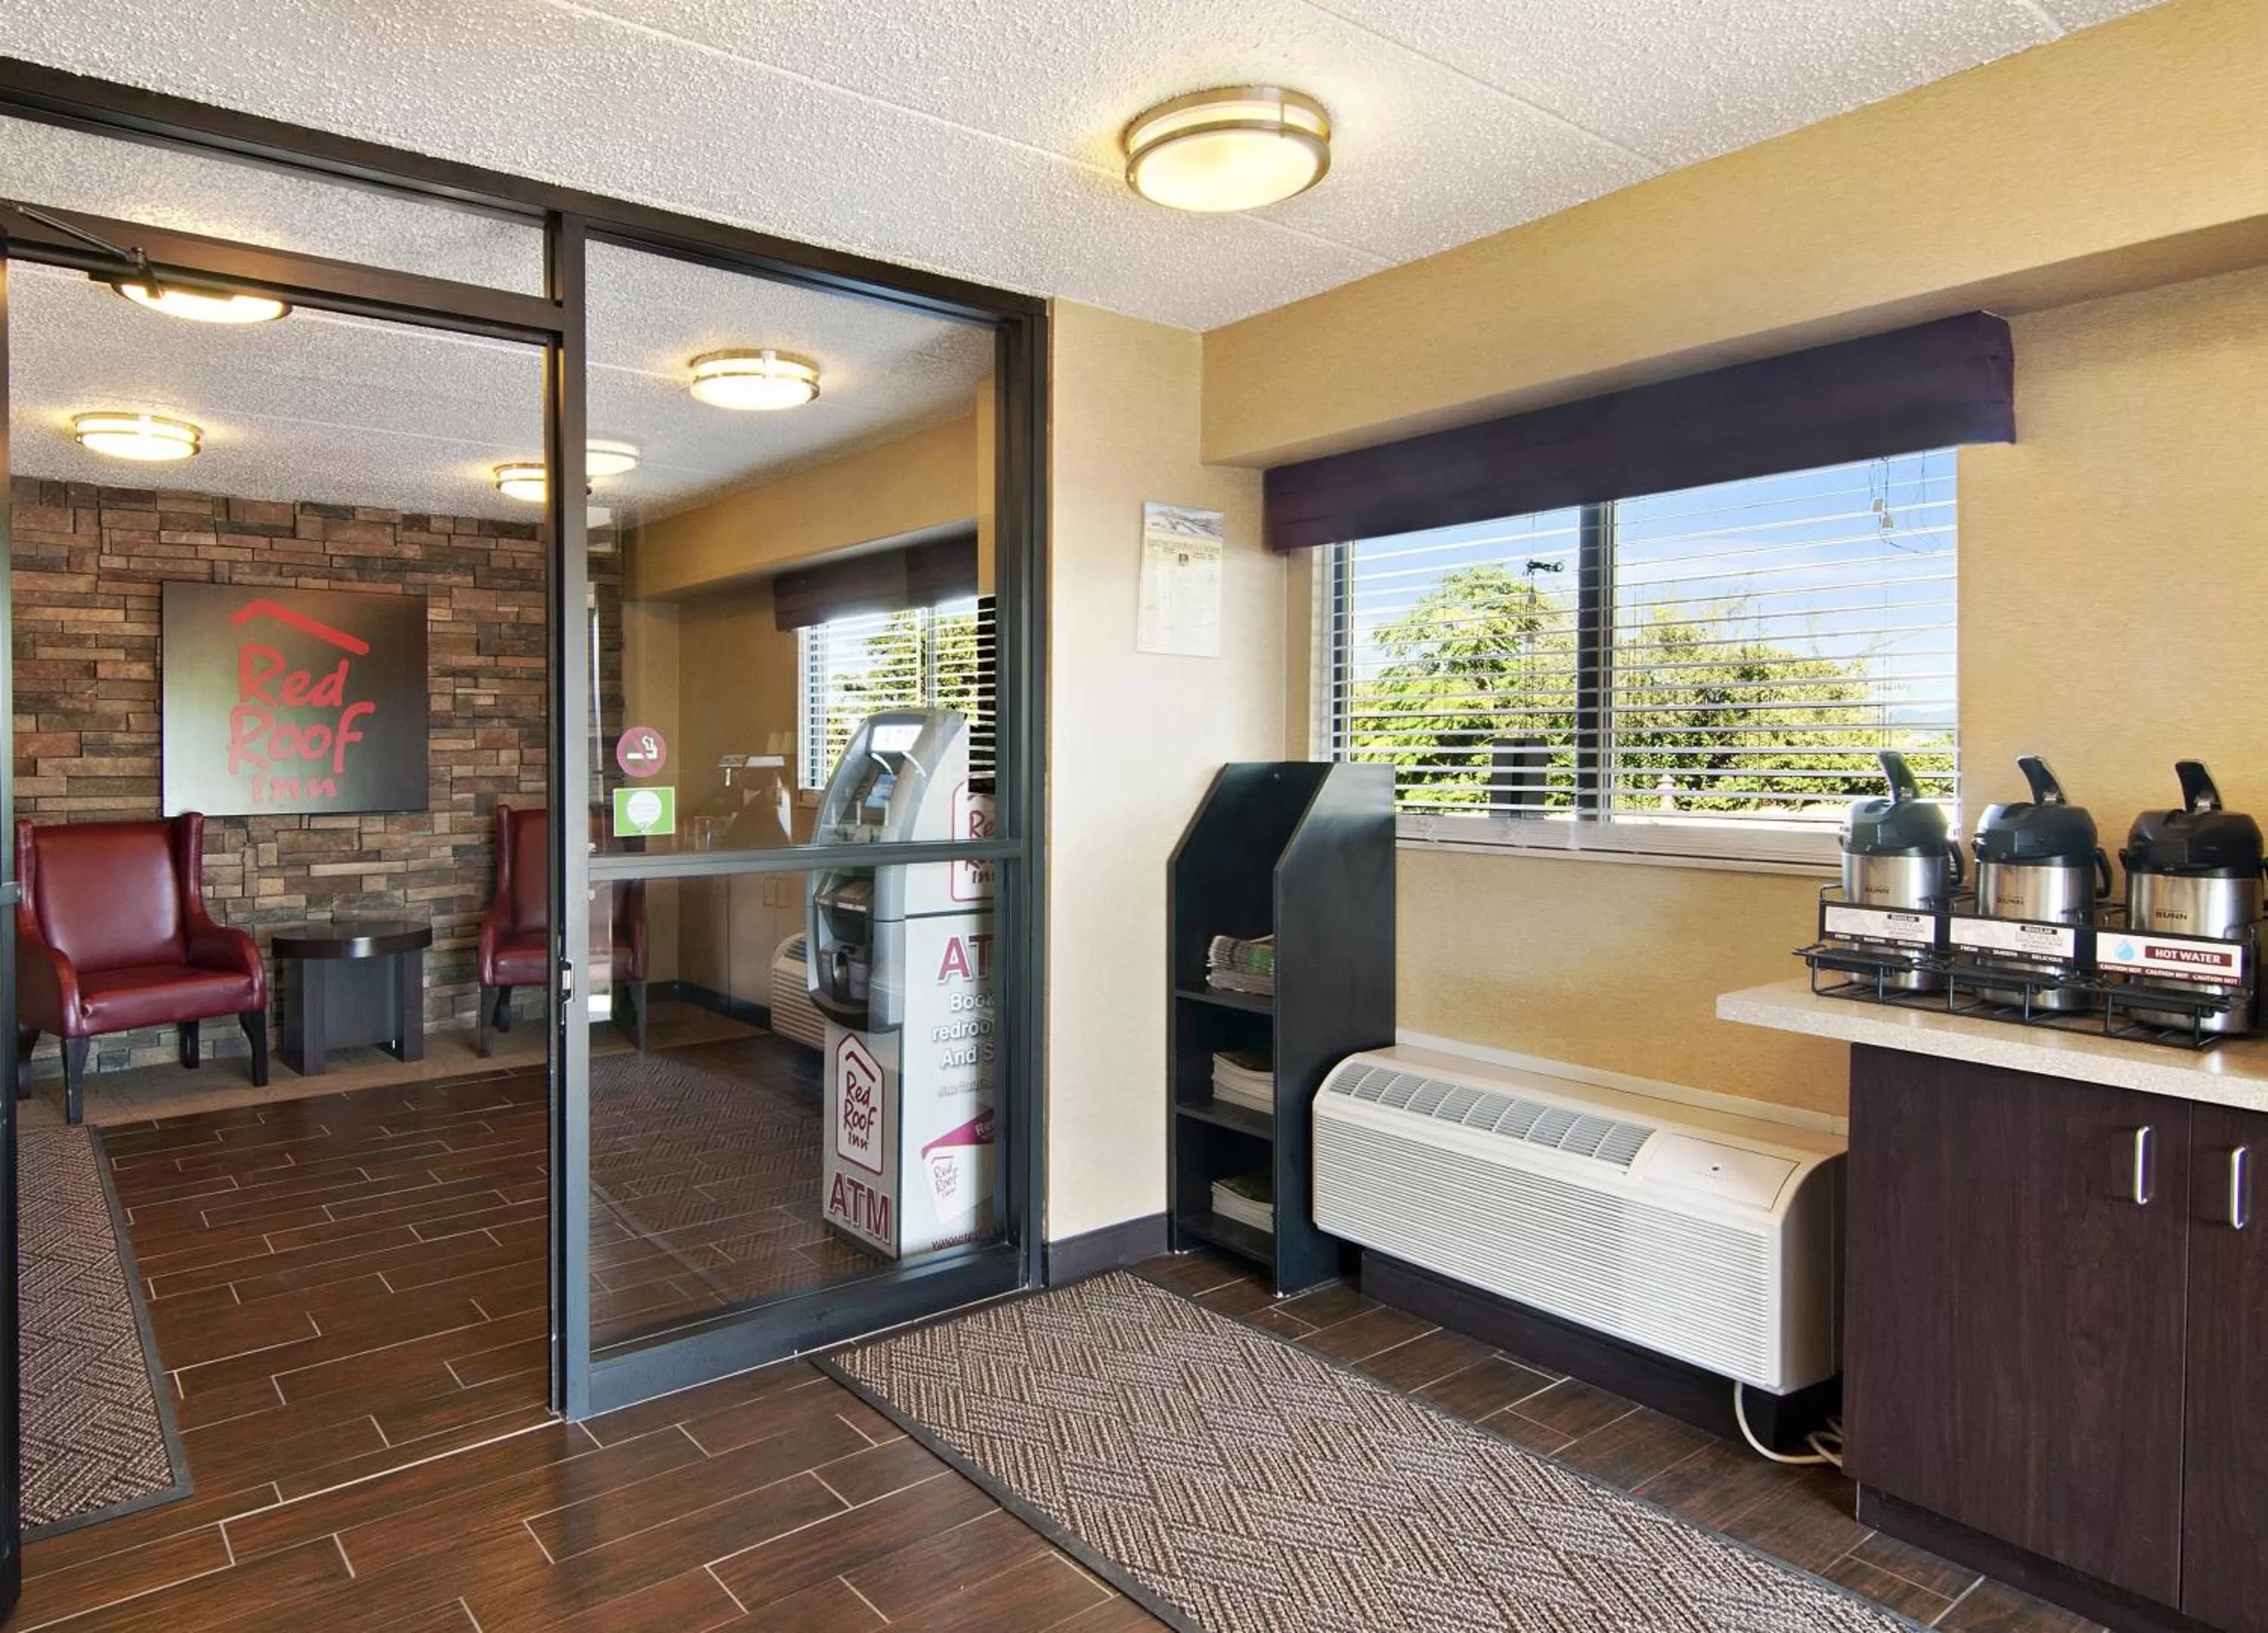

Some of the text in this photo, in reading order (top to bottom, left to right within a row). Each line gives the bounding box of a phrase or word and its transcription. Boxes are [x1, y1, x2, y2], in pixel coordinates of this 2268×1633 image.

[239, 644, 350, 707] Red
[228, 702, 375, 775] Roof
[2155, 910, 2188, 920] BUNN
[937, 934, 994, 983] AT
[2100, 964, 2127, 972] CAUTION
[2146, 968, 2174, 978] CAUTION
[2193, 975, 2223, 984] CAUTION
[2155, 949, 2221, 964] HOT WATER
[940, 1046, 978, 1067] And
[846, 1071, 871, 1106] Red
[844, 1098, 877, 1138] Roof
[829, 1171, 891, 1244] ATM
